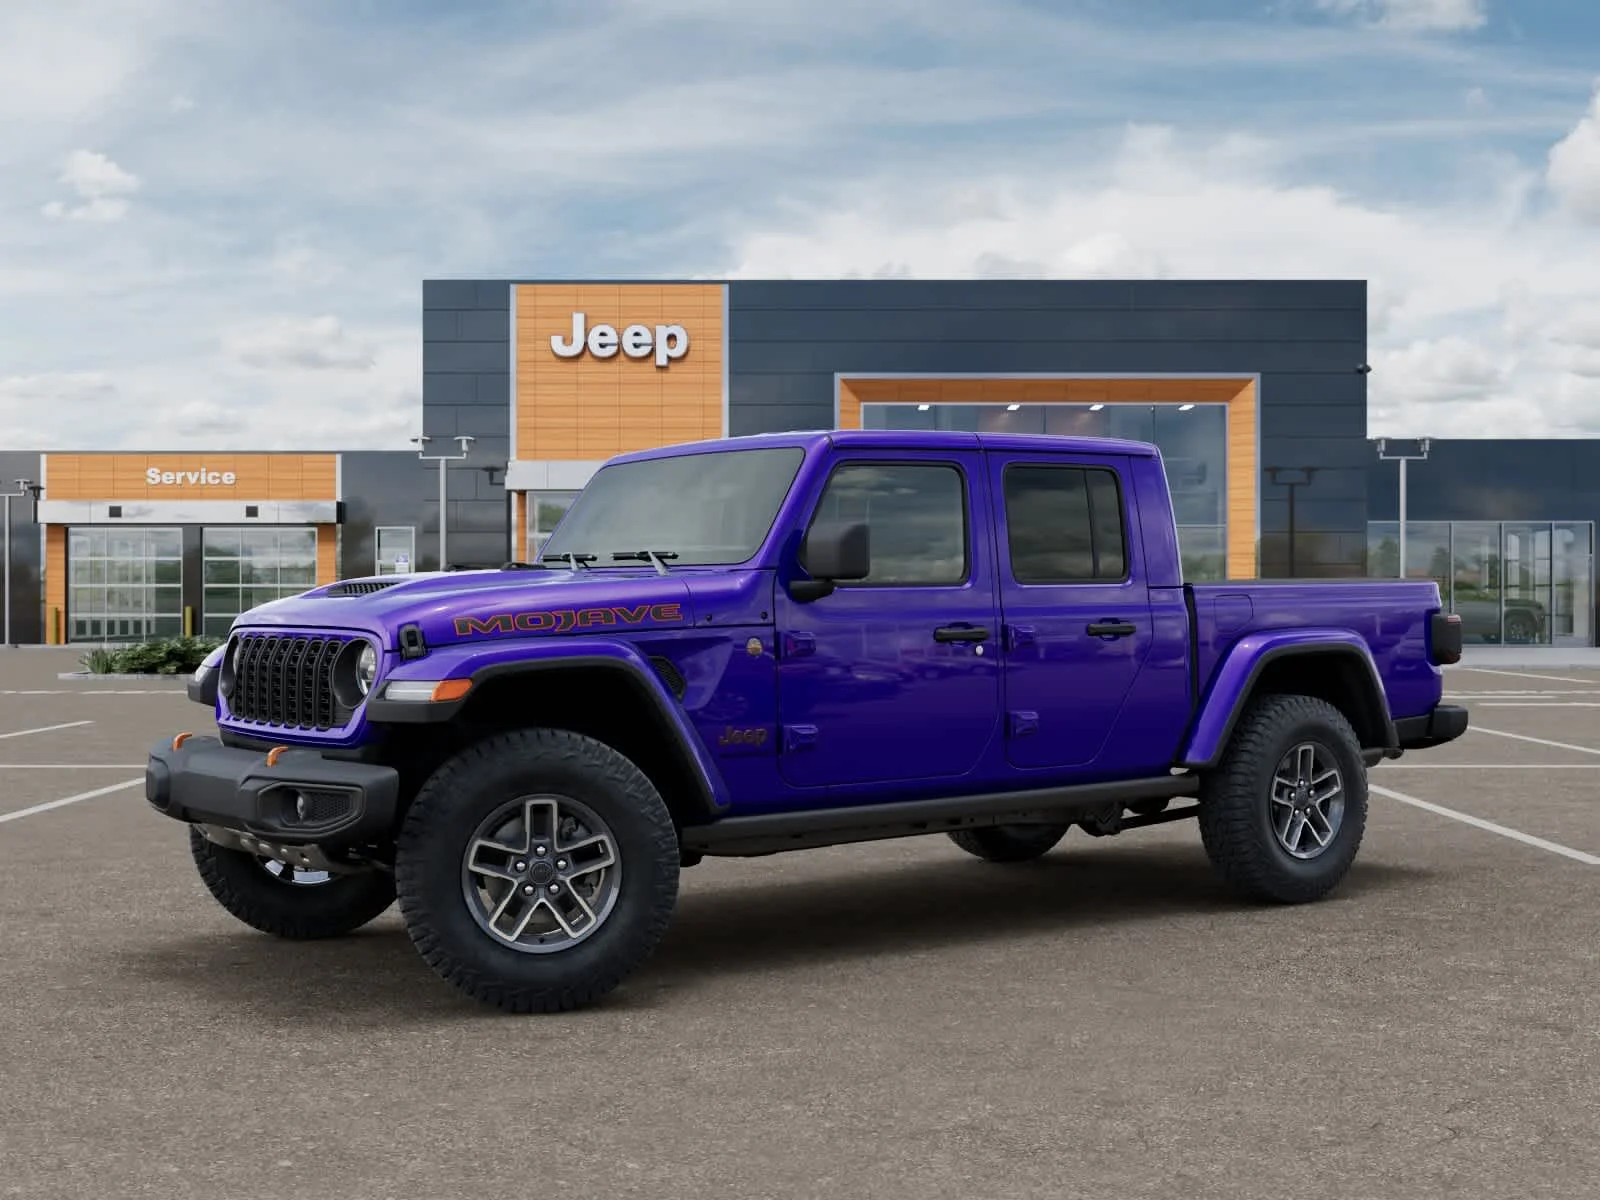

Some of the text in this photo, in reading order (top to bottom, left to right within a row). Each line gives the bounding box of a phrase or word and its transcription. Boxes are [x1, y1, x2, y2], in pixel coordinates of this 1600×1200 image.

[550, 311, 689, 367] Jeep
[146, 467, 236, 486] Service
[454, 603, 683, 636] MOJAVE
[719, 725, 768, 747] Jeep
